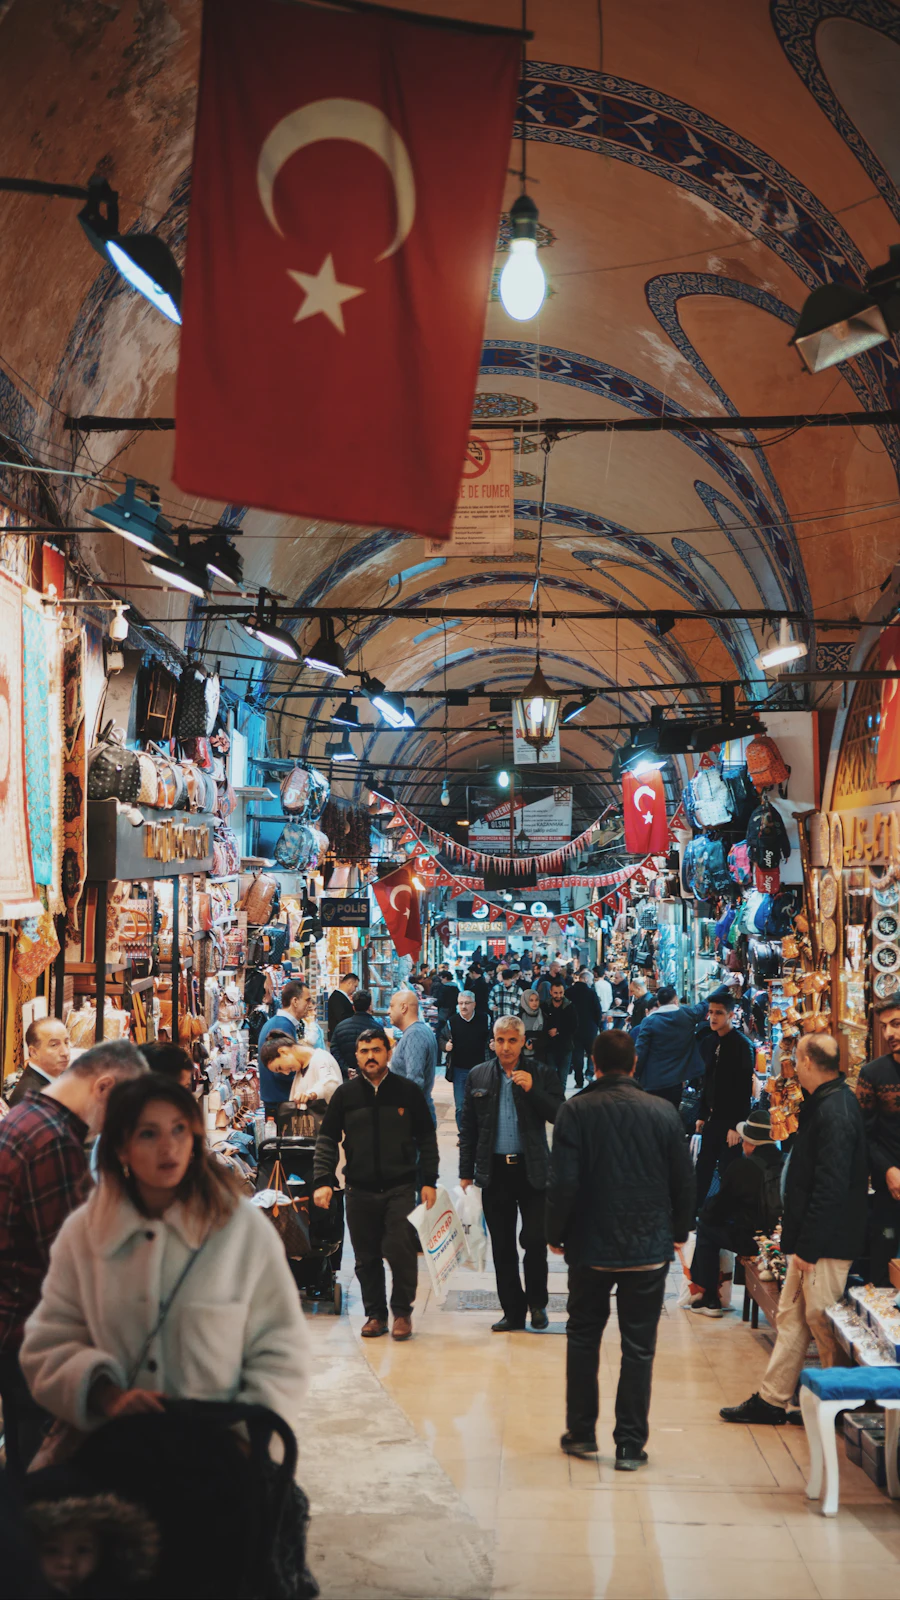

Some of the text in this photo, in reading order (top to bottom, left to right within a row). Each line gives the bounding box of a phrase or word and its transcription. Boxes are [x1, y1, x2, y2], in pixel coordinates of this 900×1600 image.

[468, 484, 479, 498] DE
[481, 484, 510, 498] FUMER
[337, 901, 367, 913] POLİS
